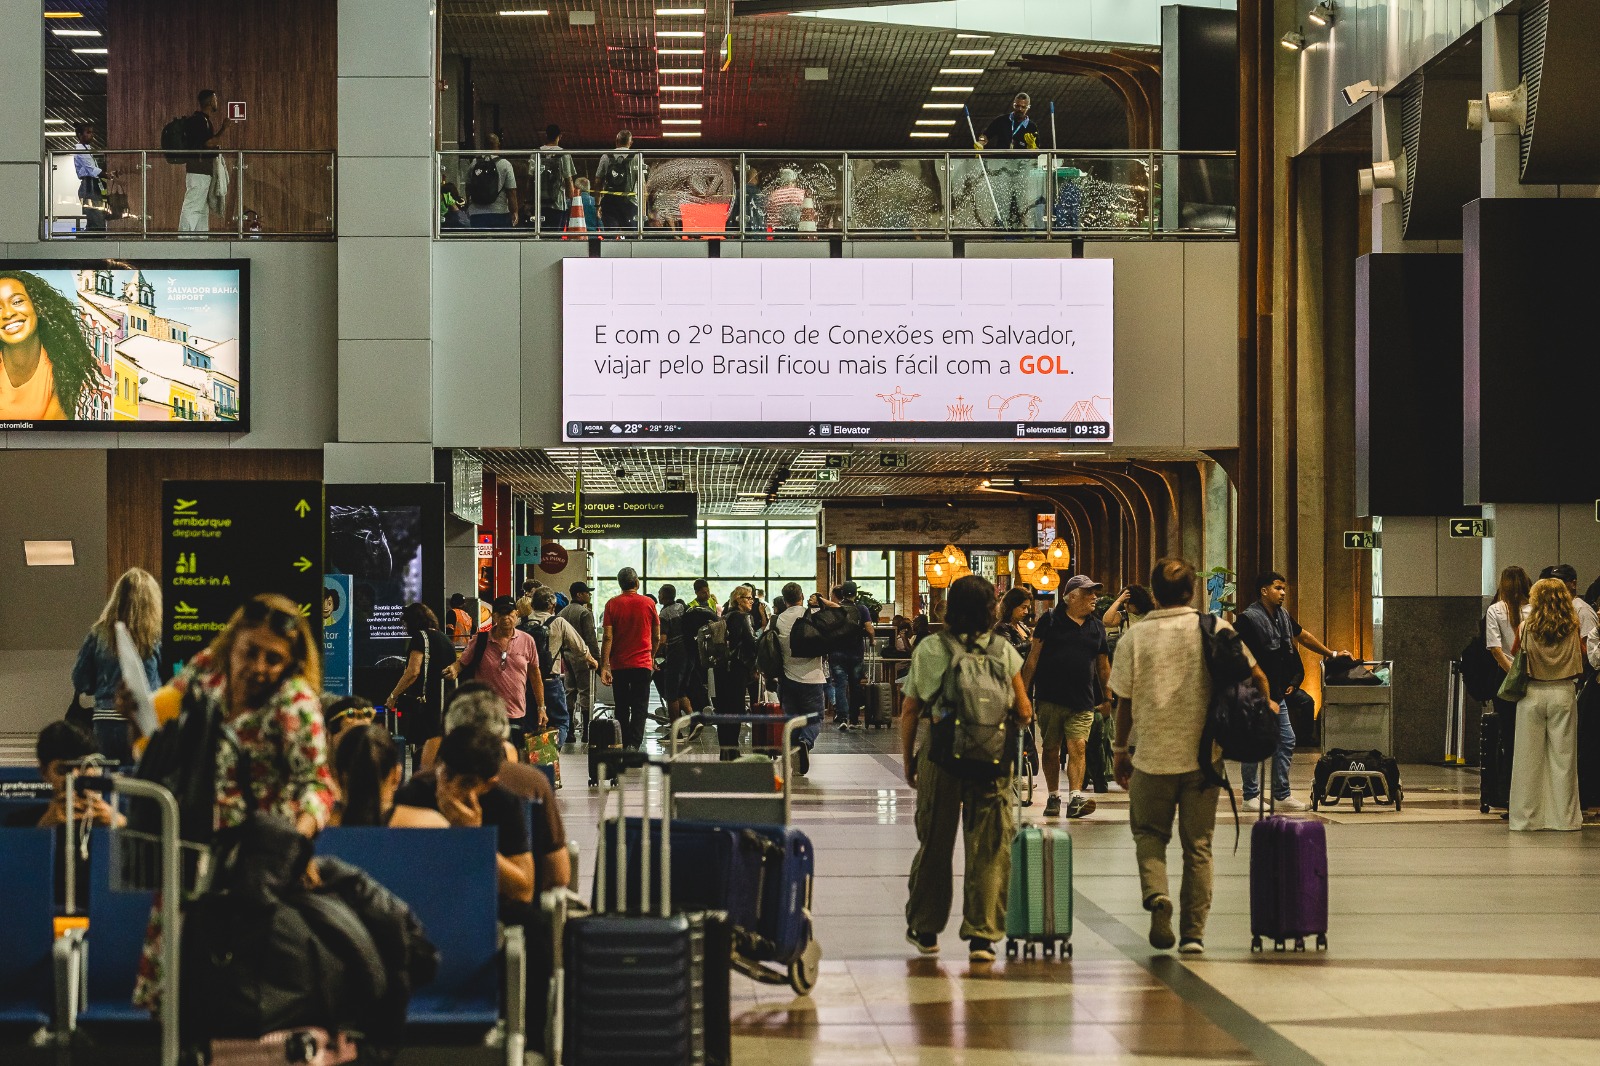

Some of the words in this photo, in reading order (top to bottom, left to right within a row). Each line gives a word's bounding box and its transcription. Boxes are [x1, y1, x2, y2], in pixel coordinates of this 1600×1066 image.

[595, 324, 607, 344] E
[615, 329, 659, 344] com
[667, 329, 680, 344] o
[721, 324, 785, 344] Banco
[794, 325, 820, 344] de
[828, 324, 934, 344] Conexões
[942, 329, 974, 344] em
[982, 325, 1076, 347] Salvador,
[594, 354, 651, 379] viajar
[660, 355, 704, 379] pelo
[713, 355, 768, 374] Brasil
[777, 355, 830, 374] ficou
[839, 355, 887, 374] mais
[896, 354, 938, 374] fácil
[946, 359, 991, 374] com
[999, 359, 1011, 374] a
[1019, 355, 1074, 375] GOL.
[833, 425, 871, 434] Elevator
[1026, 426, 1067, 434] eletromidia
[1074, 425, 1106, 434] 09:33
[623, 502, 665, 512] Departure
[173, 517, 232, 528] embarque
[172, 529, 222, 538] departure
[173, 576, 220, 586] check-in
[222, 575, 231, 586] A
